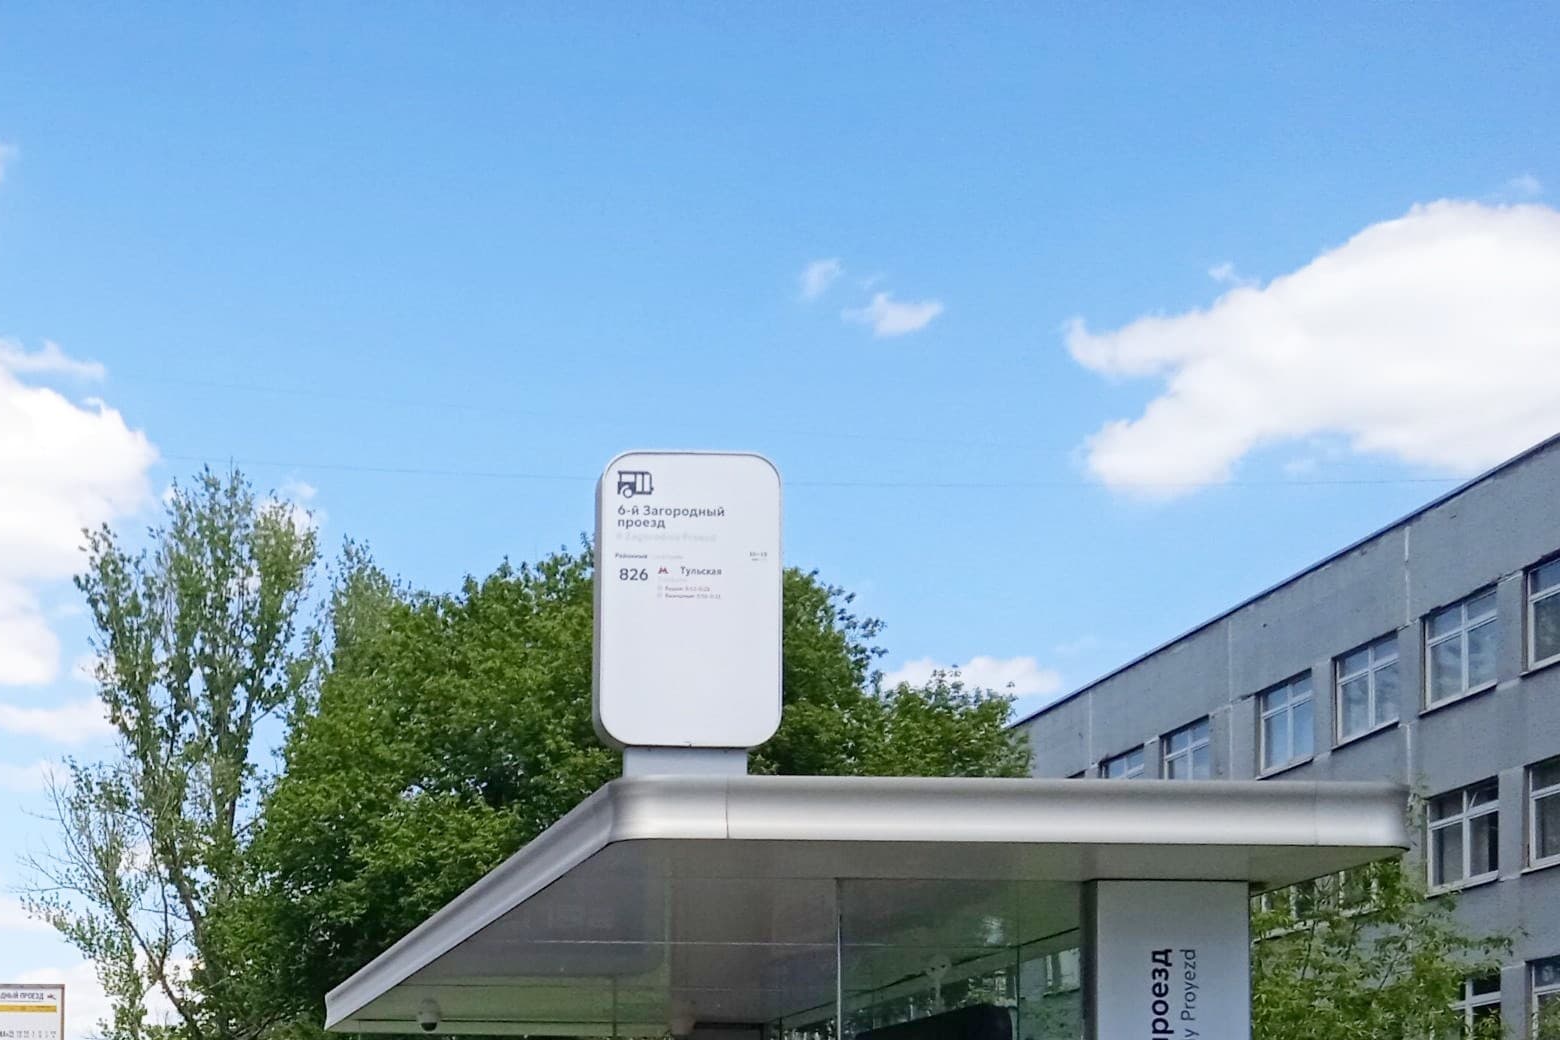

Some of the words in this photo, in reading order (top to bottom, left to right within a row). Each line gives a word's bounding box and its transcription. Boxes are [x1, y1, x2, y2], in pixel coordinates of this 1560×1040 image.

[618, 505, 639, 516] 6-й
[643, 505, 725, 518] Загородный
[617, 518, 666, 529] проезд
[619, 568, 649, 581] 826
[680, 566, 722, 576] Тульская
[1180, 947, 1202, 1023] Proyezd
[20, 992, 44, 1001] ПРОЕЗД
